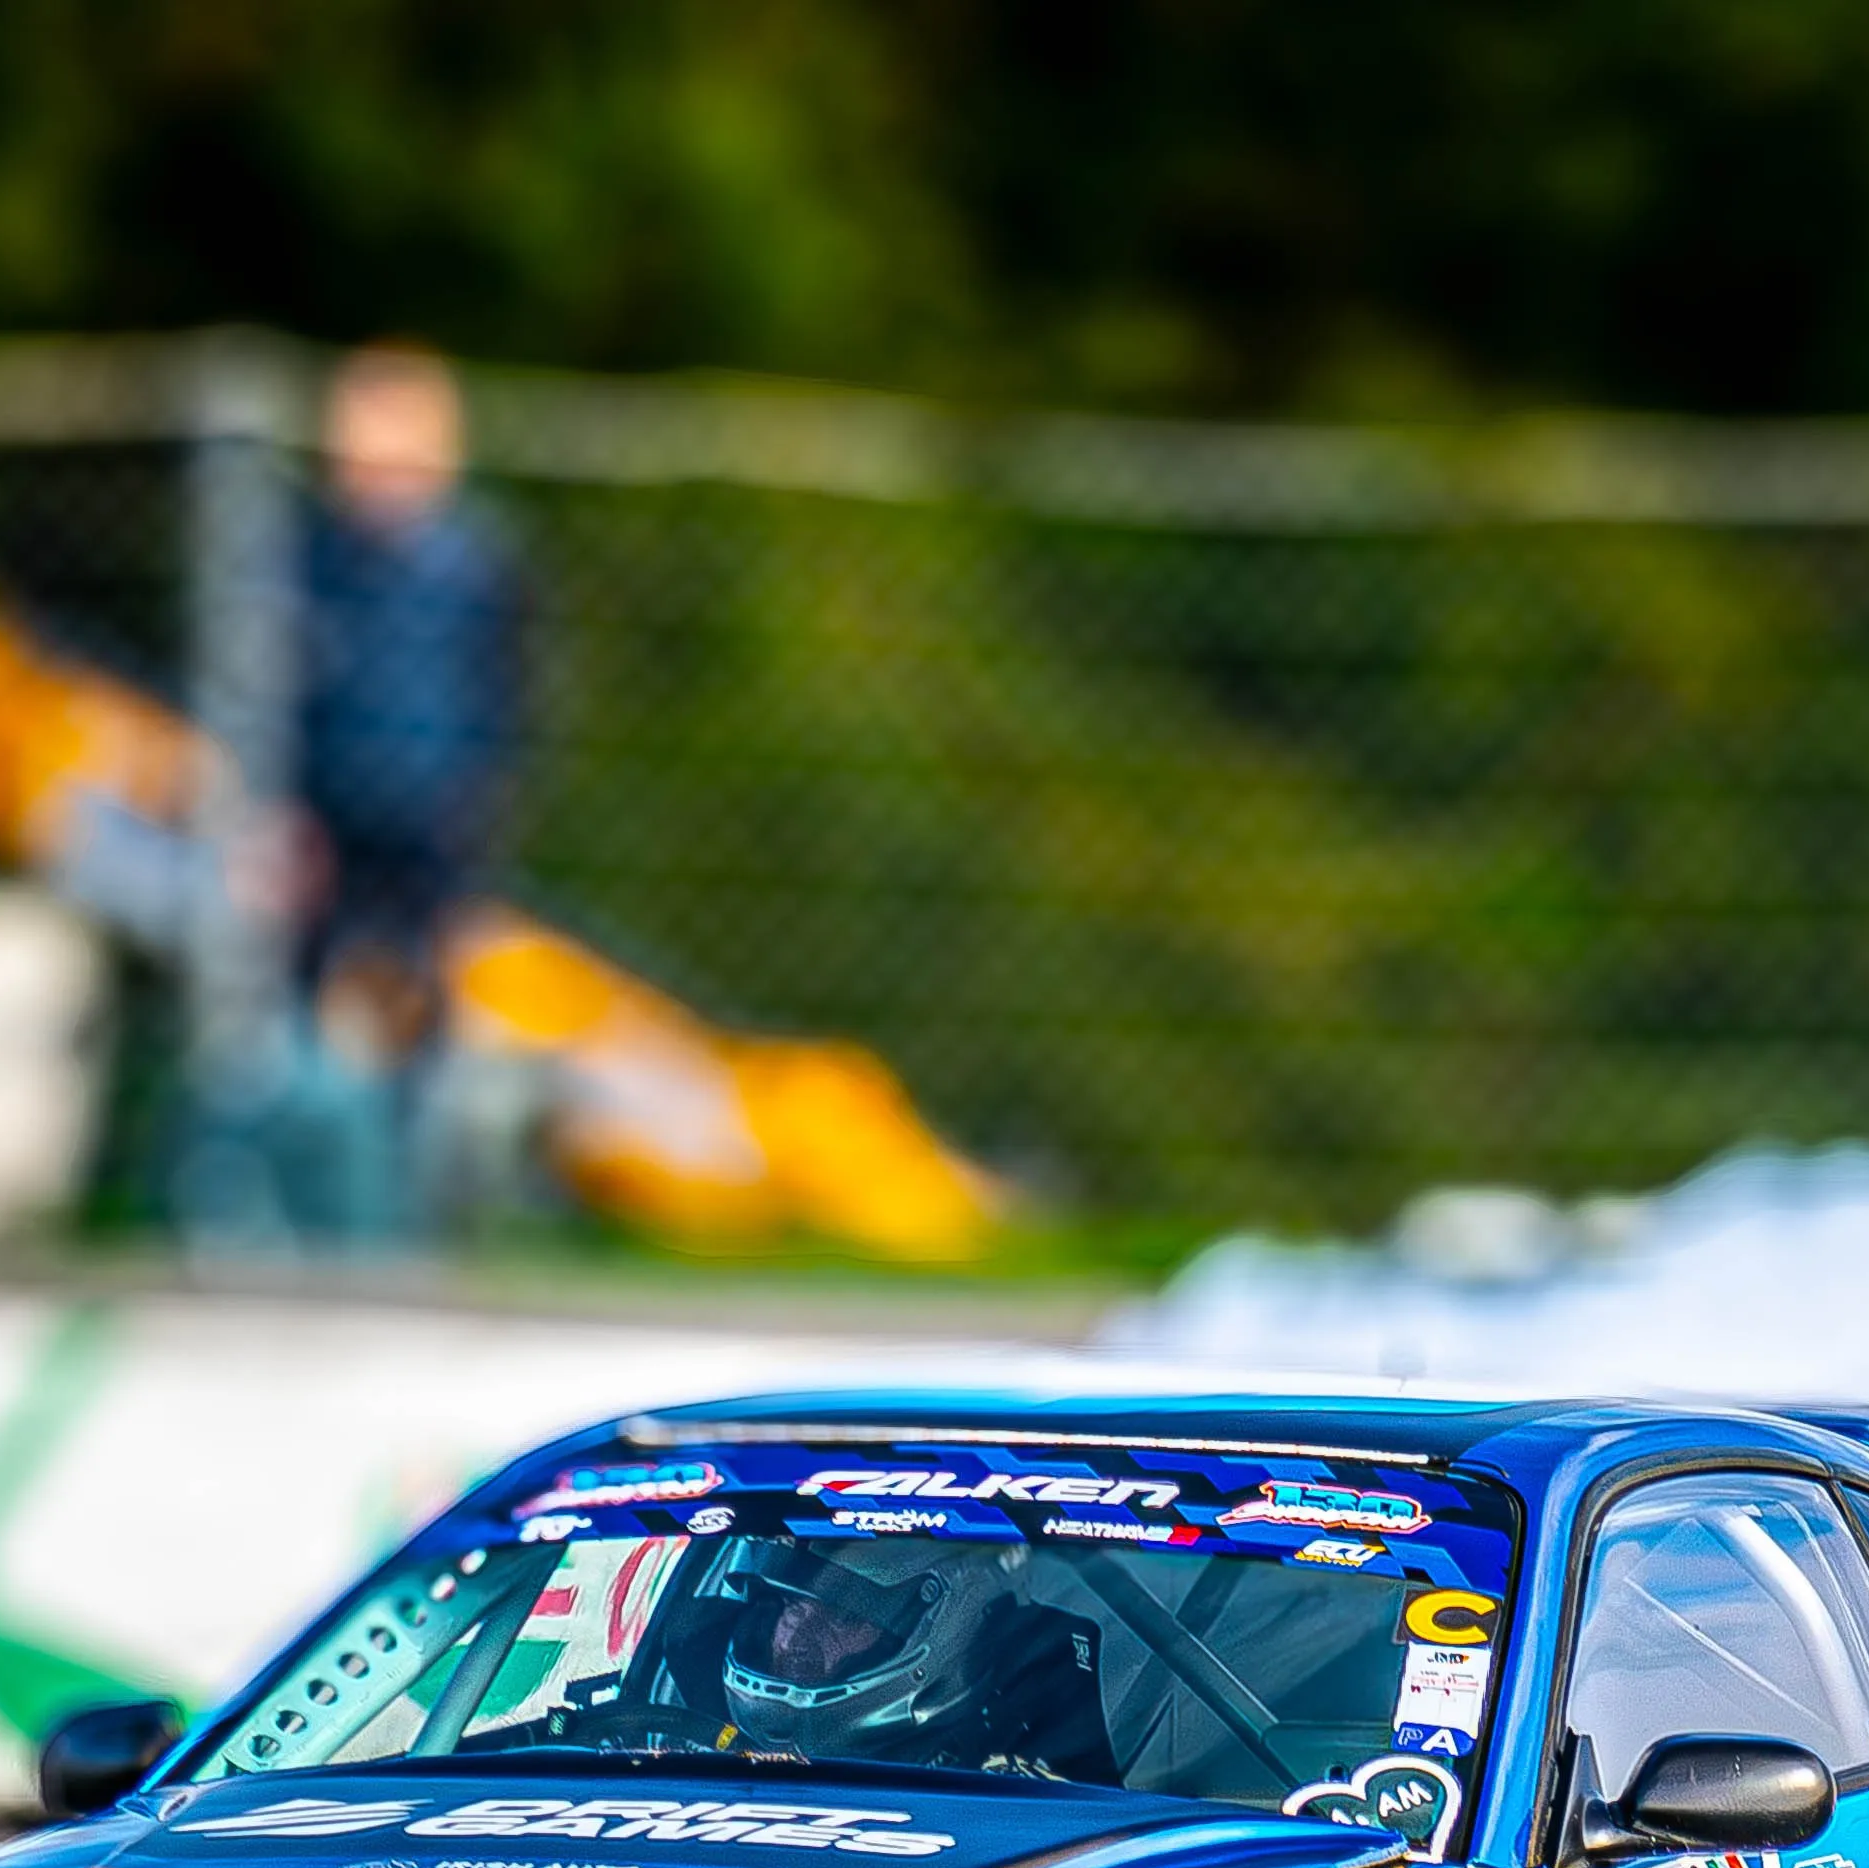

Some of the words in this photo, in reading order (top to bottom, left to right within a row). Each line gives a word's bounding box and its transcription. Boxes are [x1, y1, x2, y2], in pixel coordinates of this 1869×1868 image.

[796, 1471, 1179, 1508] FALKEN
[1405, 1590, 1496, 1644] C
[443, 1800, 912, 1827] DRIFT
[404, 1816, 955, 1855] GAMES
